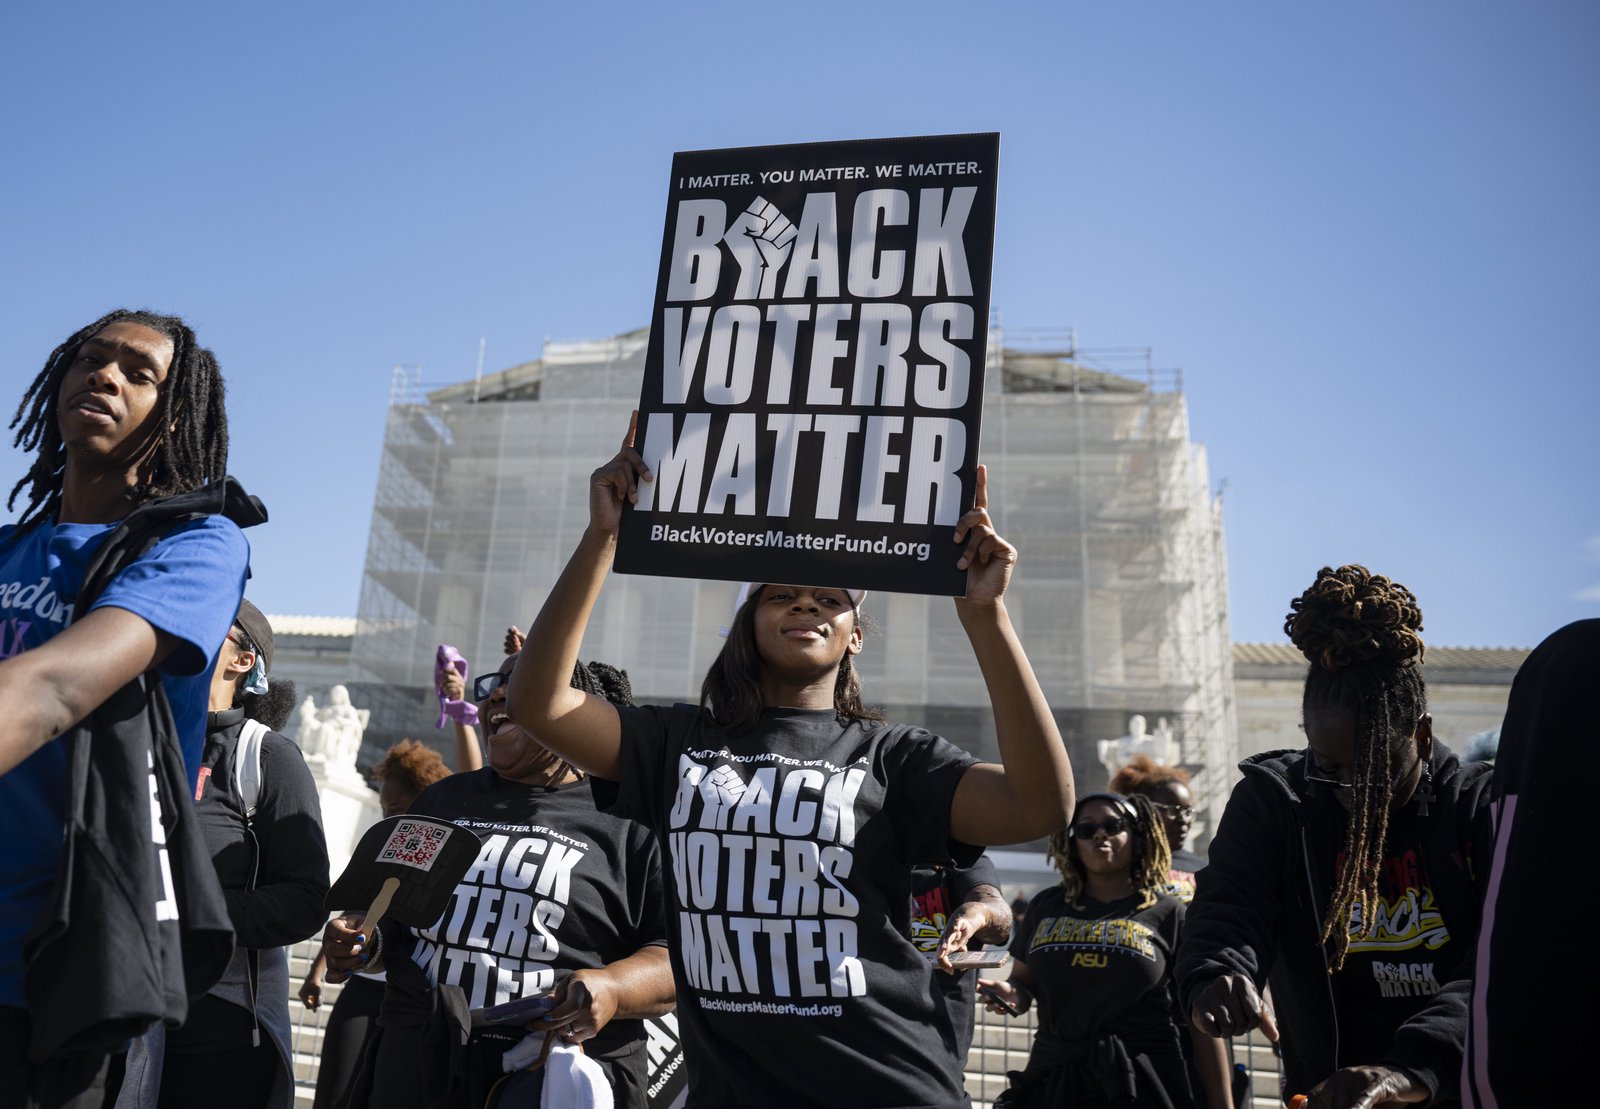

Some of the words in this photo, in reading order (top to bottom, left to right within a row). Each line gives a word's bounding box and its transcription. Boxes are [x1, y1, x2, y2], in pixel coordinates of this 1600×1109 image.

[679, 177, 684, 189] I
[688, 173, 754, 188] MATTER.
[760, 170, 795, 184] YOU
[799, 166, 870, 182] MATTER.
[875, 164, 903, 179] WE
[908, 161, 983, 177] MATTER.
[662, 302, 975, 409] VOTERS
[634, 412, 967, 527] MATTER
[650, 524, 931, 562] BlackVotersMatterFund.org
[731, 753, 753, 763] YOU
[754, 753, 801, 766] MATTER.
[804, 759, 823, 767] WE
[824, 756, 869, 773] MATR.
[492, 822, 531, 832] MATTER.
[532, 825, 549, 834] WE
[548, 829, 589, 851] MATTER.
[463, 834, 585, 906] ACK
[669, 831, 860, 917] VOTERS
[410, 883, 566, 961] TERS
[679, 911, 867, 997] MATTER
[1071, 952, 1108, 968] ASU
[699, 997, 842, 1017] BlackVotersMatterFund.org
